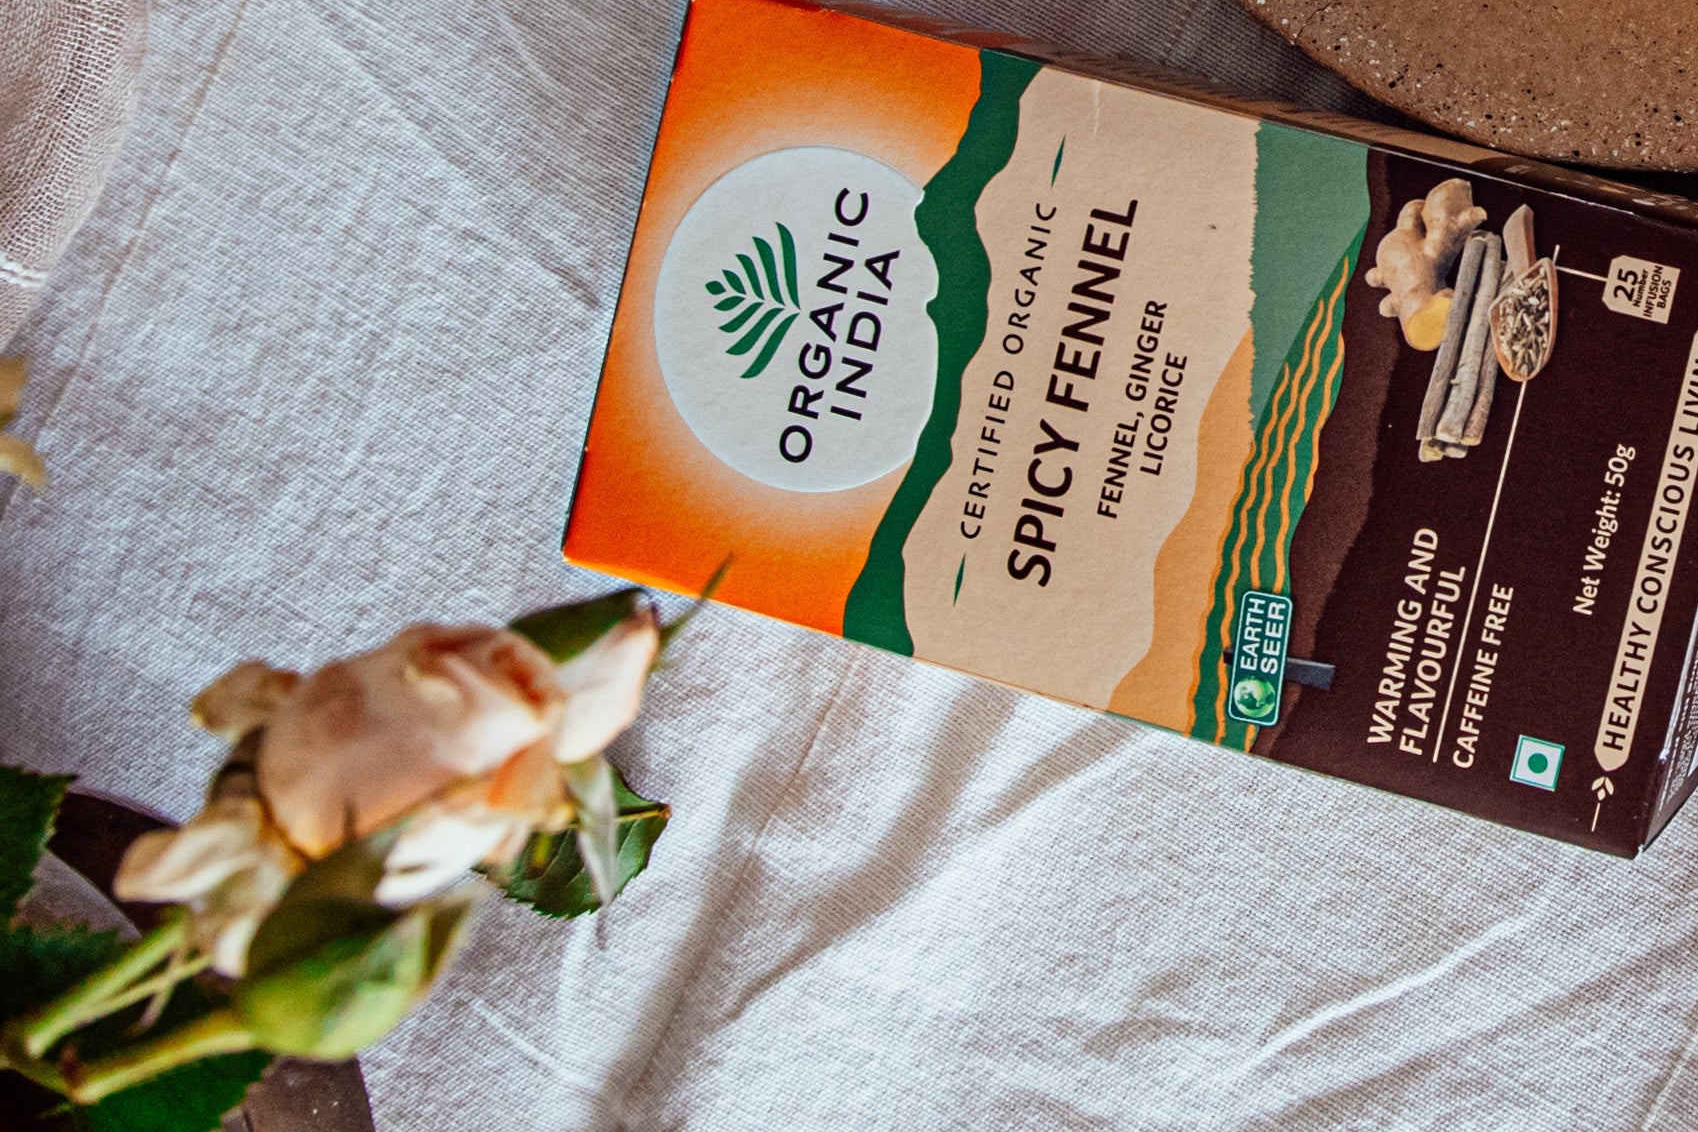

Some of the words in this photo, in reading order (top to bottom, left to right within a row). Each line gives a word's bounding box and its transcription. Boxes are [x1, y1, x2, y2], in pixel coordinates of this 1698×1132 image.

[779, 187, 869, 463] ORGANIC
[830, 250, 900, 421] INDIA
[1613, 267, 1639, 301] 25
[1633, 269, 1650, 307] Number
[1642, 264, 1664, 318] INFUSION
[1656, 278, 1672, 308] BAGS
[961, 370, 1016, 539] CERTIFIED
[1002, 203, 1057, 353] ORGANIC
[1007, 419, 1080, 587] SPICY
[1045, 199, 1139, 412] FENNEL
[1097, 412, 1144, 519] FENNEL,
[1125, 300, 1168, 400] GINGER
[1139, 353, 1188, 476] LICORICE
[1604, 443, 1636, 487] 50g
[1583, 490, 1621, 571] Weight:
[1240, 597, 1266, 672] EARTH
[1260, 601, 1286, 676] SEER
[1367, 598, 1423, 745] WARMING
[1404, 527, 1438, 595] AND
[1573, 576, 1600, 616] Net
[1601, 621, 1653, 752] HEALTHY
[1636, 444, 1695, 614] CONSCIOUS
[1399, 566, 1465, 755] FLAVOURFUL
[1453, 648, 1500, 768] CAFFEINE
[1481, 584, 1514, 646] FREE
